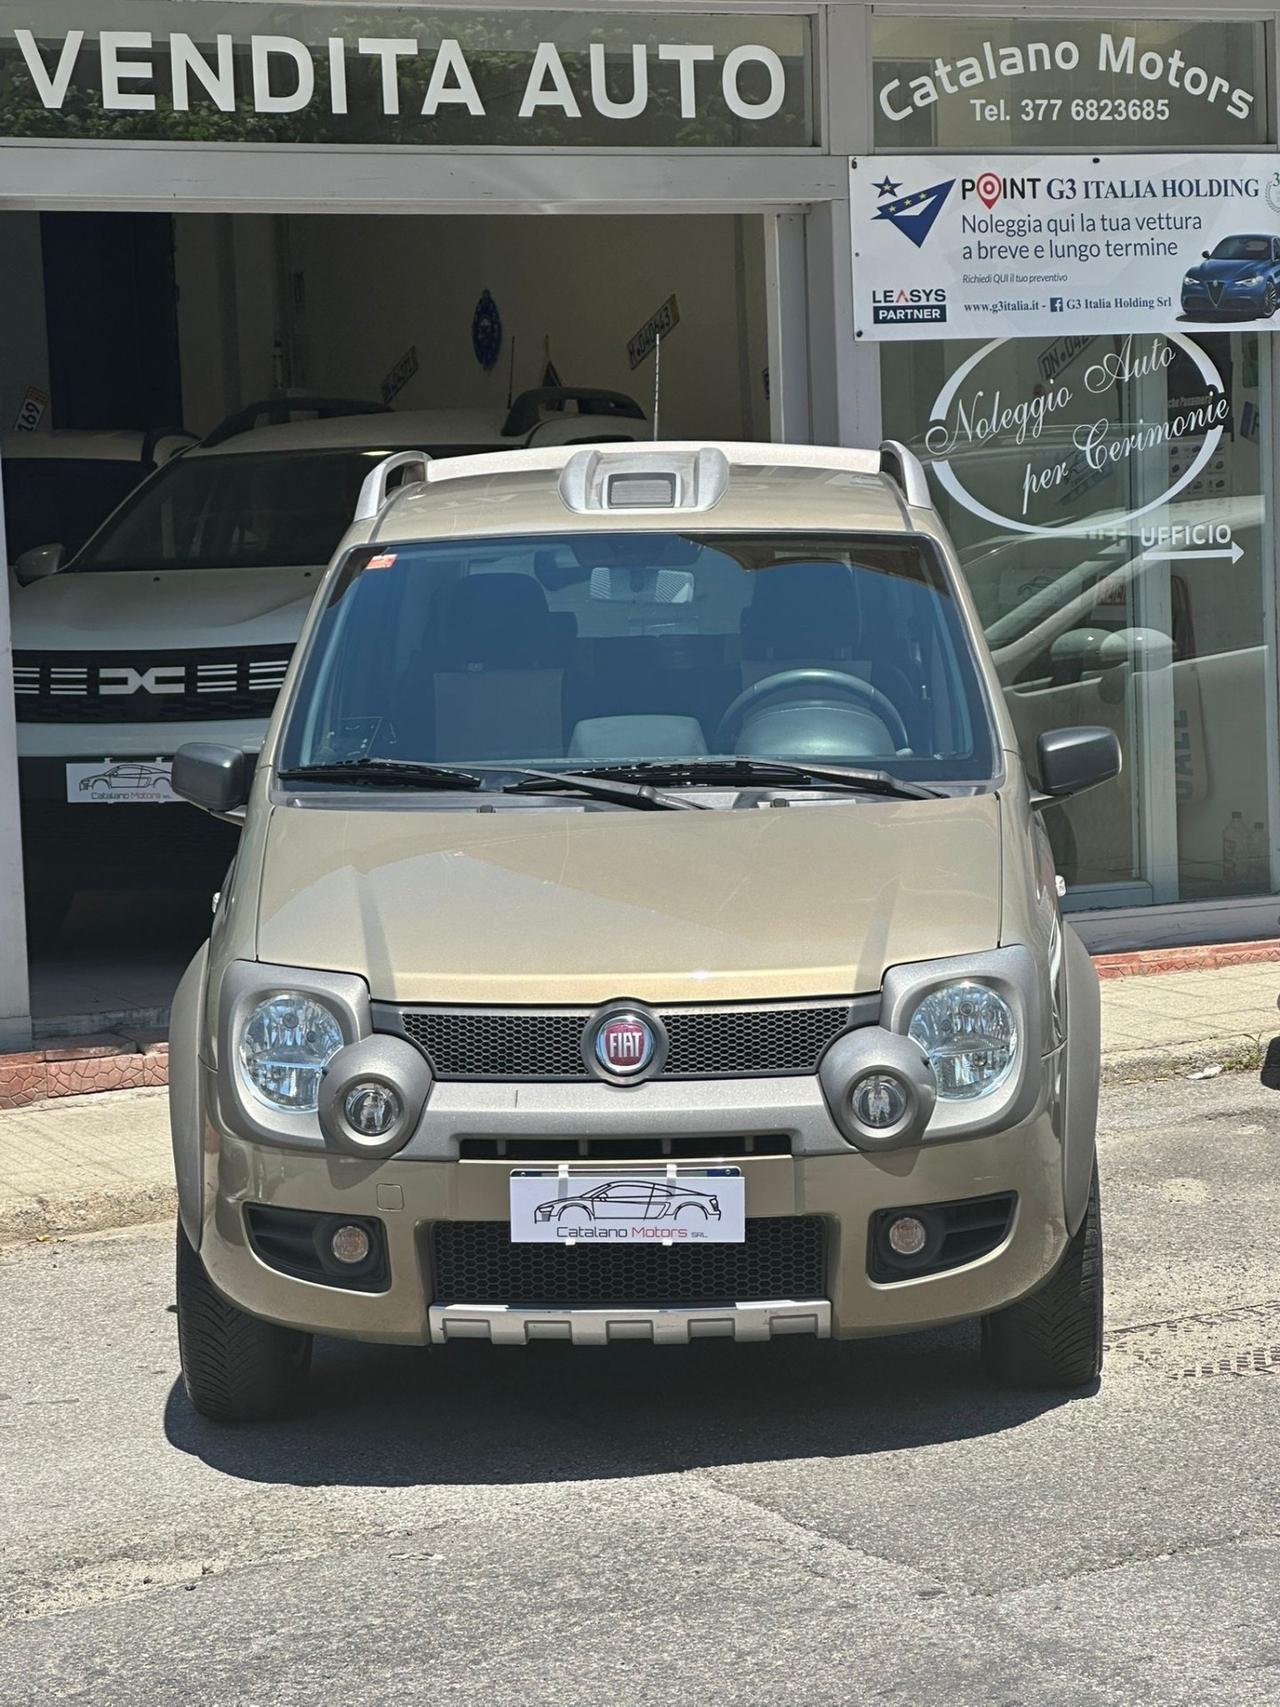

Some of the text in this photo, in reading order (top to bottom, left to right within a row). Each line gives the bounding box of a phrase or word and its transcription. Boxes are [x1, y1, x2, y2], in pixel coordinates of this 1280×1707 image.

[14, 29, 786, 120] VENDITA AUTO
[878, 33, 1254, 122] Catalano Motors
[970, 99, 1170, 121] Tel. 377 6823685
[961, 173, 1259, 206] POINT G3 ITALIA HOLDING
[962, 213, 1202, 237] Noleggia qui la tua vettura
[962, 238, 1178, 261] a breve e lungo termine
[962, 273, 992, 284] Richiedi
[993, 273, 1009, 284] QUI
[1015, 274, 1028, 283] tuo
[1028, 273, 1068, 284] preventivo
[872, 288, 946, 303] LEASYS
[964, 299, 1039, 313] www.g3italia.it
[1066, 299, 1082, 310] G3
[1085, 298, 1111, 310] Italia
[1114, 297, 1155, 310] Holding
[1157, 296, 1172, 308] Srl
[879, 308, 941, 320] PARTNER
[924, 333, 1176, 456] Noleggio Auto
[1022, 461, 1069, 515] per
[1072, 390, 1230, 472] Cerimonie
[1140, 523, 1232, 547] UFFICIO
[609, 1031, 642, 1058] FIAT
[556, 1226, 628, 1239] Catalano
[631, 1226, 688, 1239] Motors
